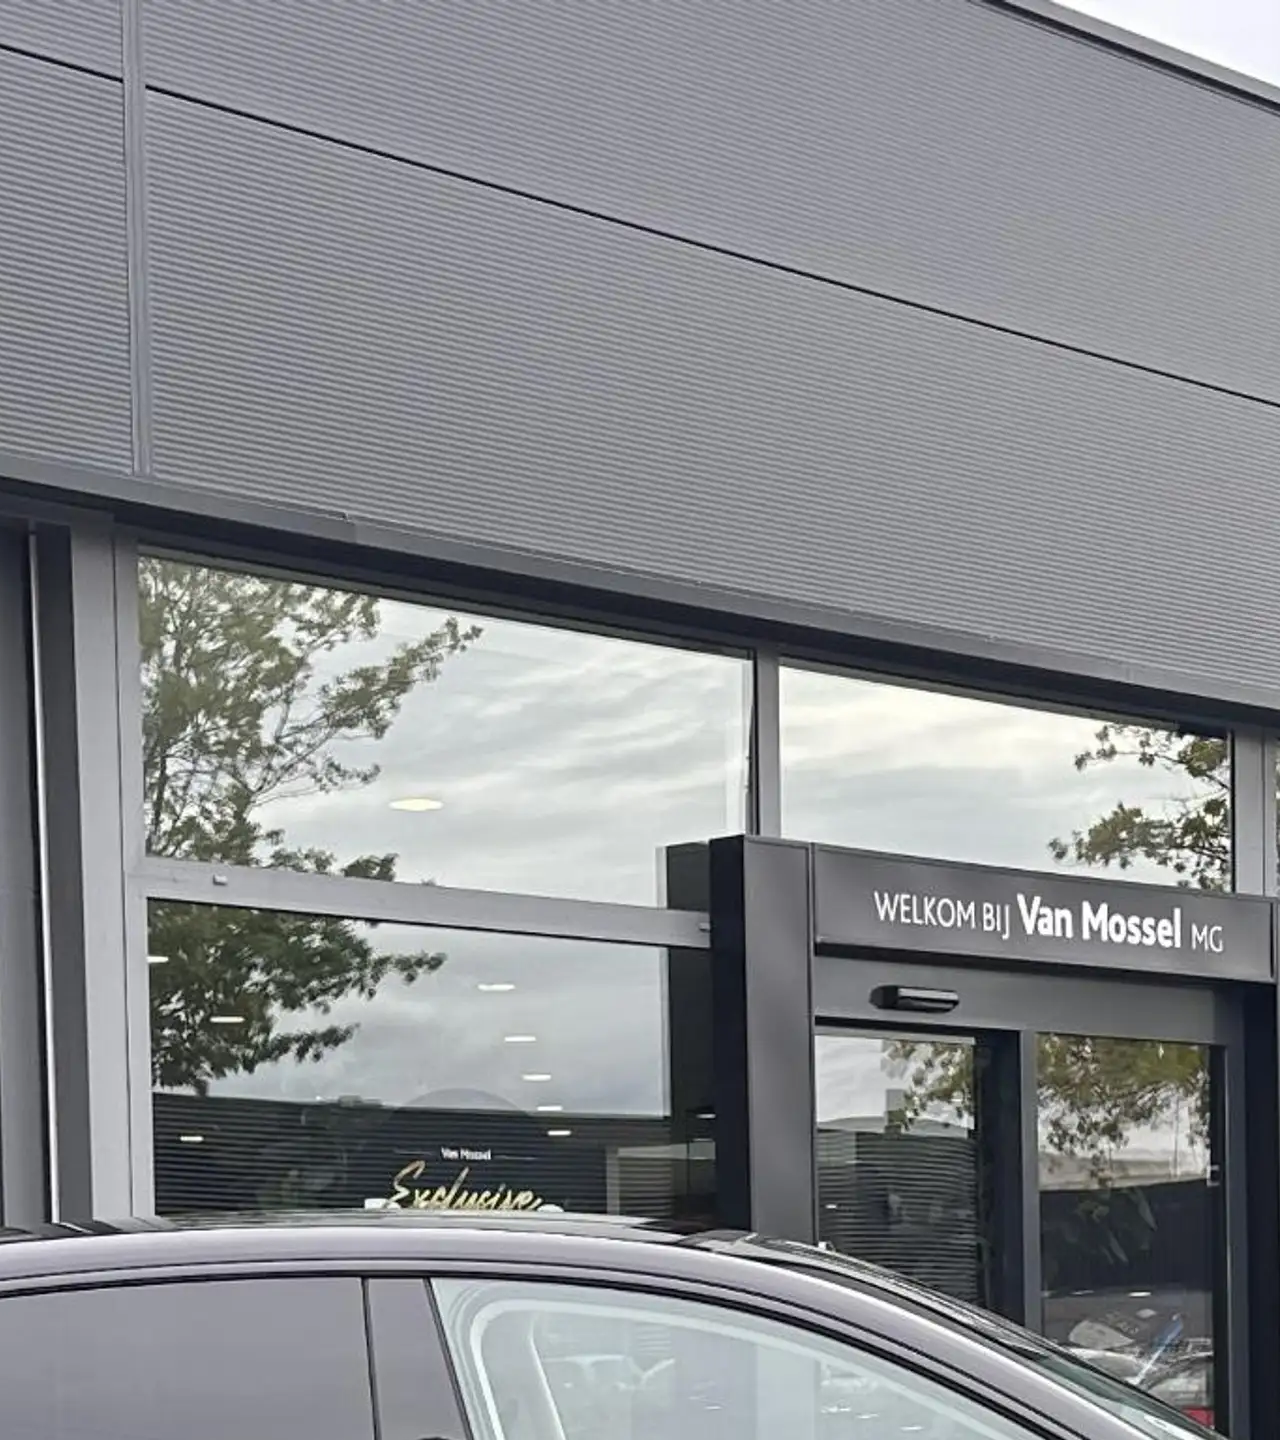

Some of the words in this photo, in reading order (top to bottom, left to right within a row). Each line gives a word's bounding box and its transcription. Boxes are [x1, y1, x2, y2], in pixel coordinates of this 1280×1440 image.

[874, 891, 976, 930] WELKOM
[982, 902, 1011, 940] BIJ
[1017, 893, 1074, 939] Van
[1082, 900, 1182, 948] Mossel
[1191, 923, 1224, 953] MG
[388, 1160, 542, 1210] Exclusive
